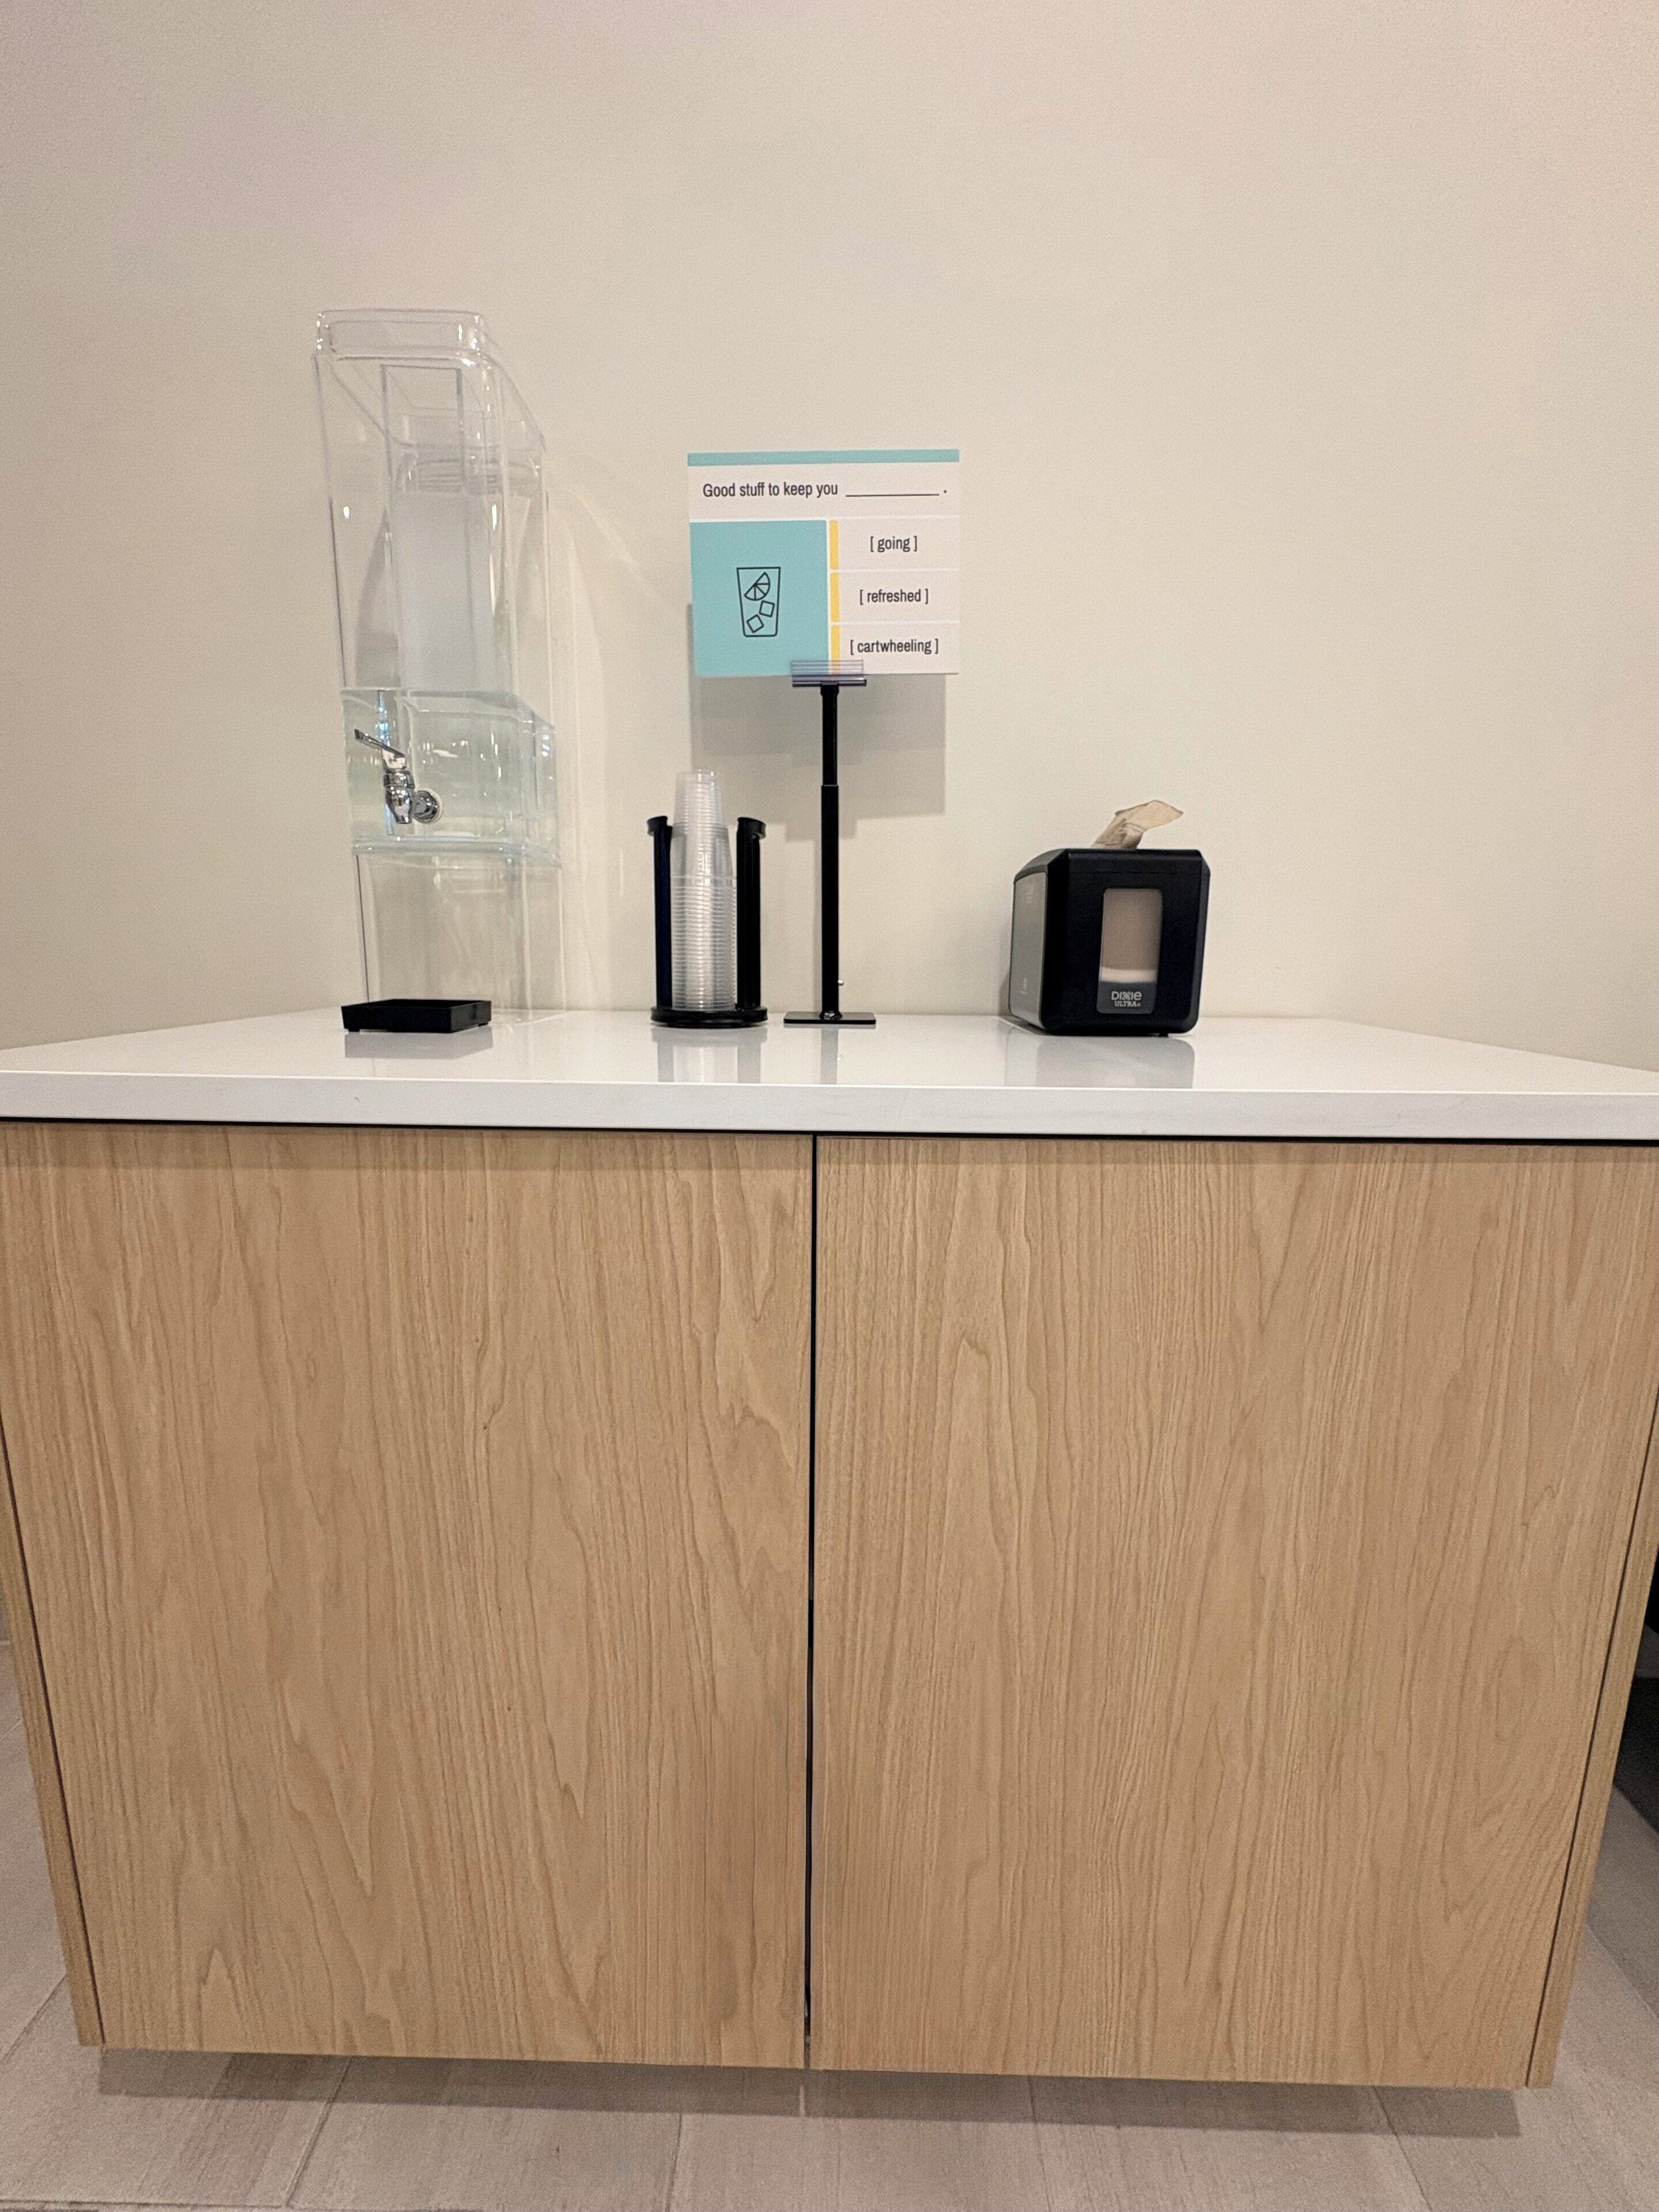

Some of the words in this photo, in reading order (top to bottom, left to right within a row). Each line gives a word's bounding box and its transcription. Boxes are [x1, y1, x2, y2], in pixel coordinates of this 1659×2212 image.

[702, 482, 736, 498] Good
[739, 482, 766, 497] stuff
[768, 482, 780, 497] to
[783, 481, 813, 499] keep
[816, 484, 838, 499] you
[877, 537, 911, 553] going
[867, 588, 921, 603] refreshed
[857, 638, 932, 655] cartwheeling
